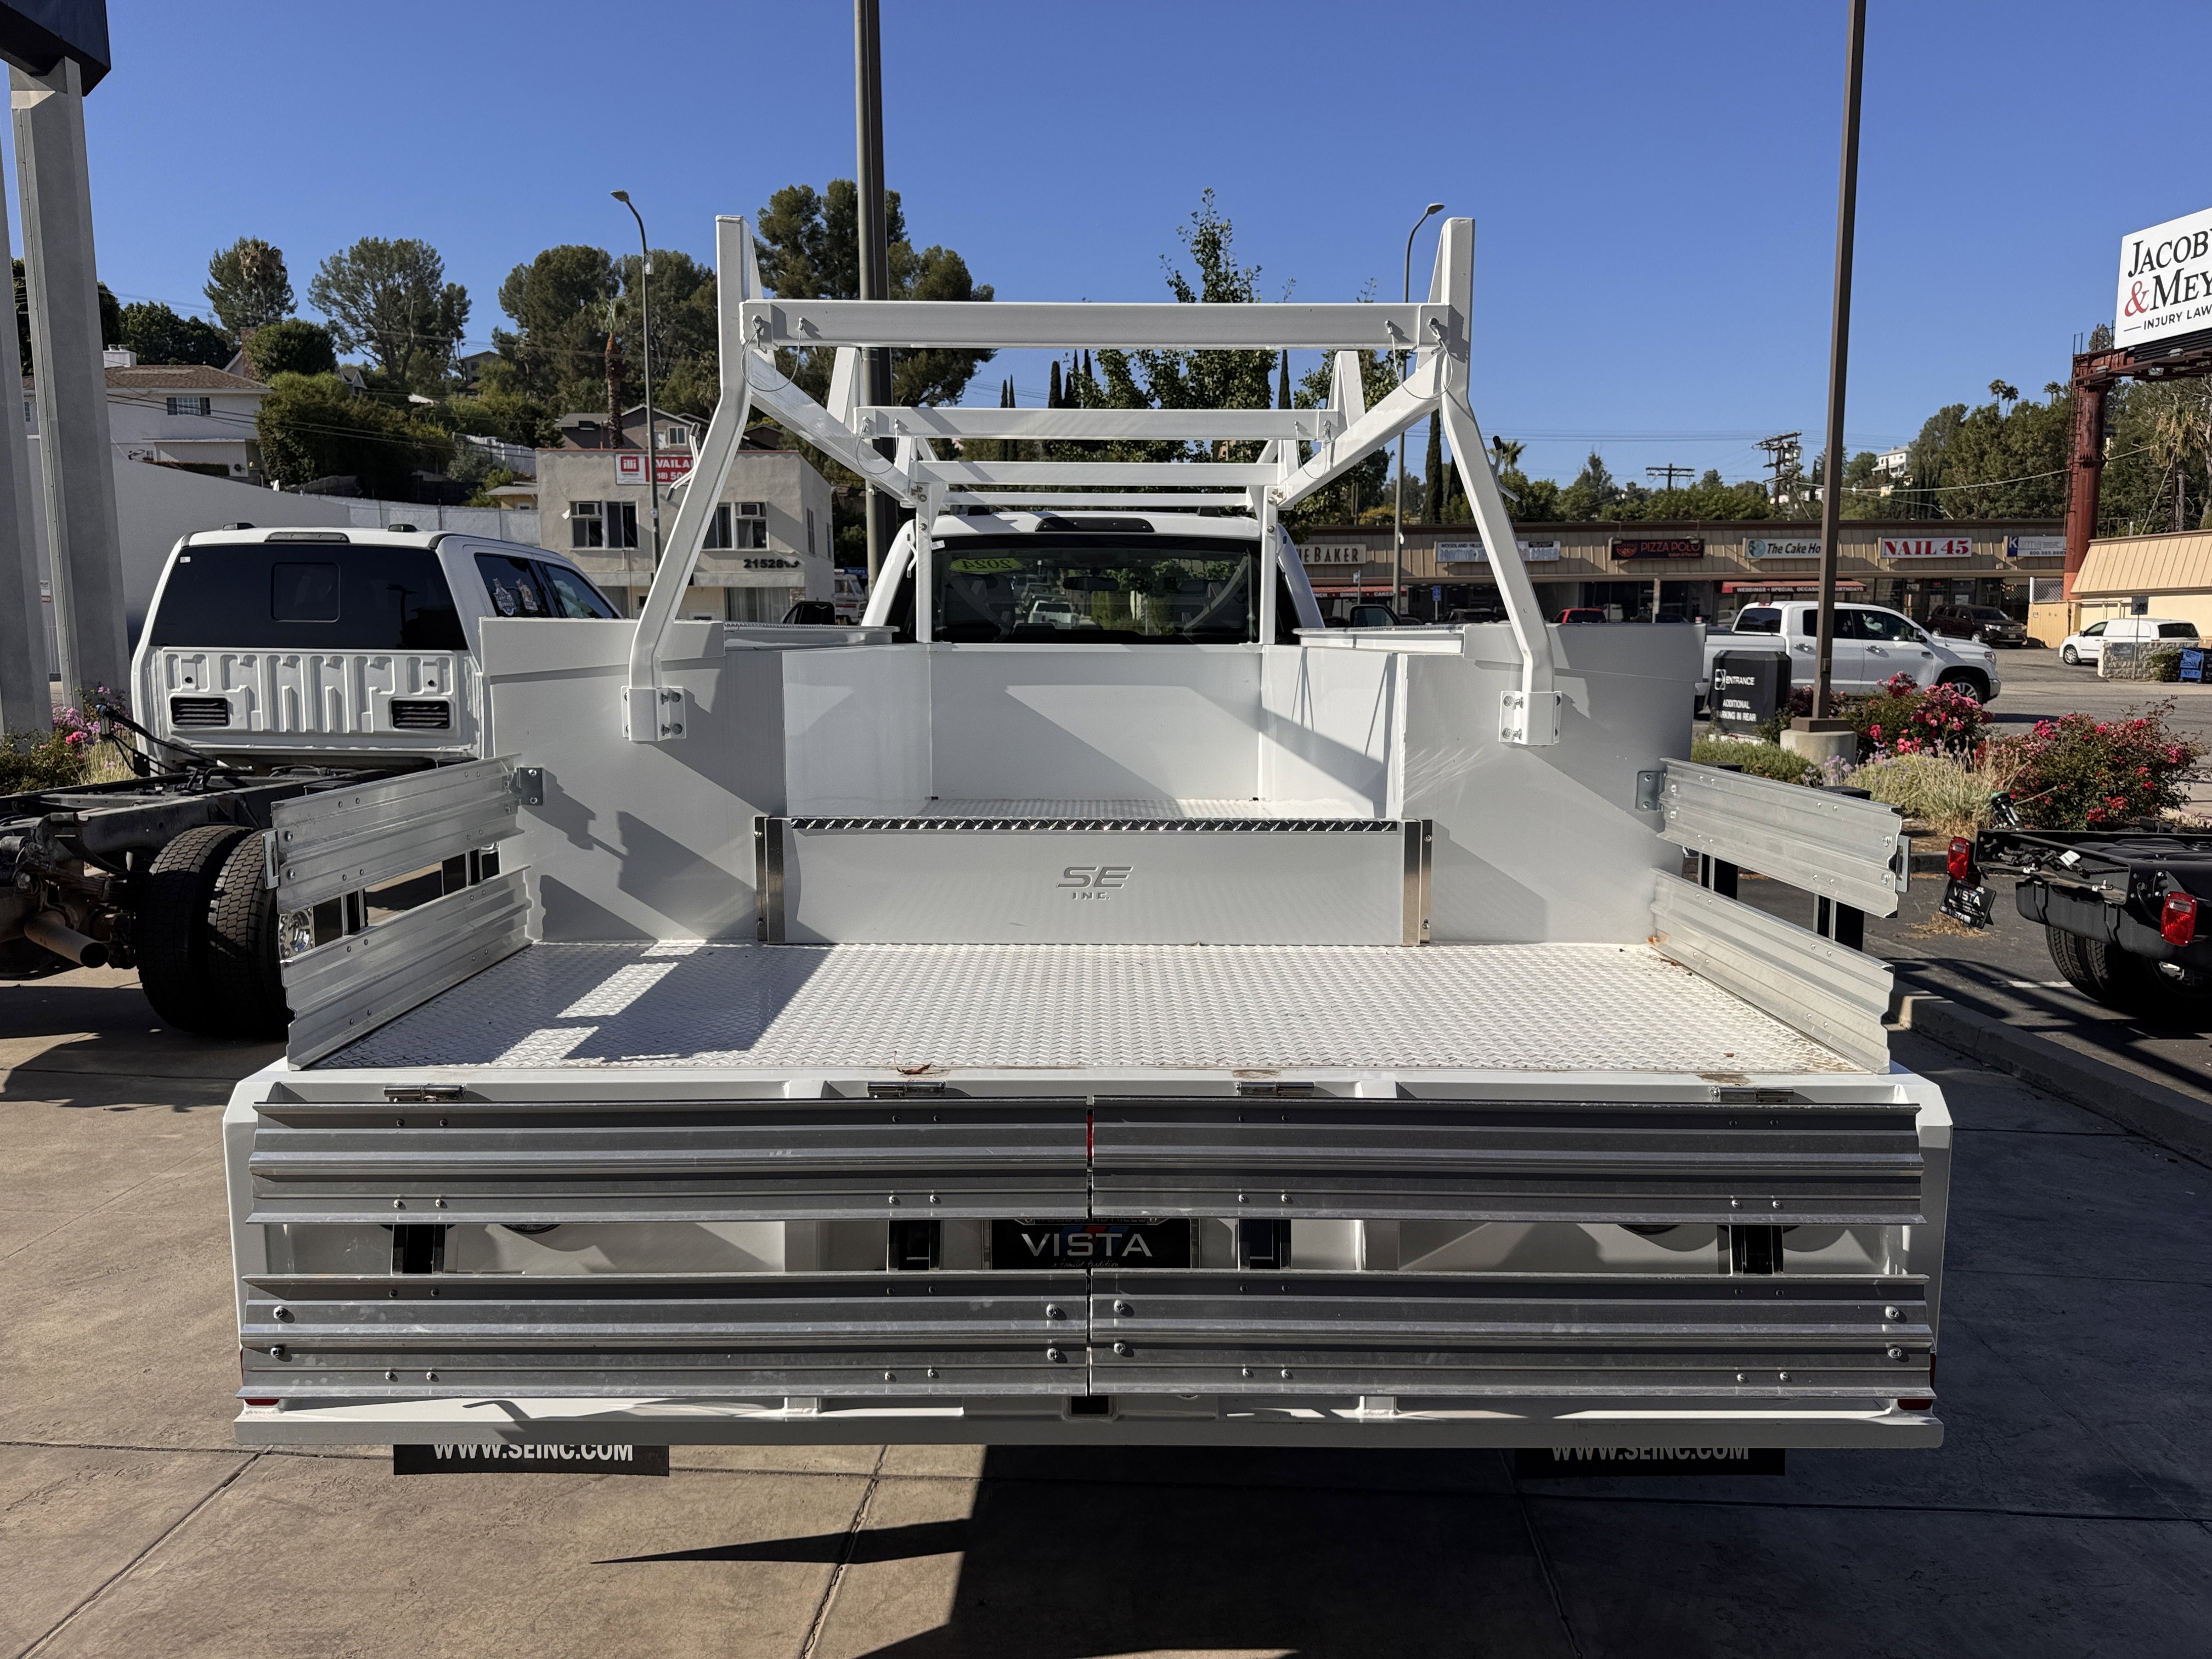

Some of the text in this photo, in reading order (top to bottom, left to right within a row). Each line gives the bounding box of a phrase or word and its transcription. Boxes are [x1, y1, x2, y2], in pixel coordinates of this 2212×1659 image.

[2128, 228, 2212, 278] JACOB
[2143, 311, 2183, 330] INJURY
[656, 459, 694, 469] VAILA
[1641, 541, 1669, 552] PIZZA
[1767, 543, 1821, 554] The Cake Ho
[1883, 540, 1969, 556] NAIL 45
[1314, 547, 1358, 562] BAKER
[1725, 675, 1756, 686] ENTRANCE
[1723, 699, 1751, 709] ADDITIONAL
[1736, 712, 1742, 720] IN
[1743, 712, 1757, 722] REAR
[1057, 866, 1133, 889] SE
[1954, 886, 1980, 907] VISTA
[1021, 1233, 1153, 1257] VISTA
